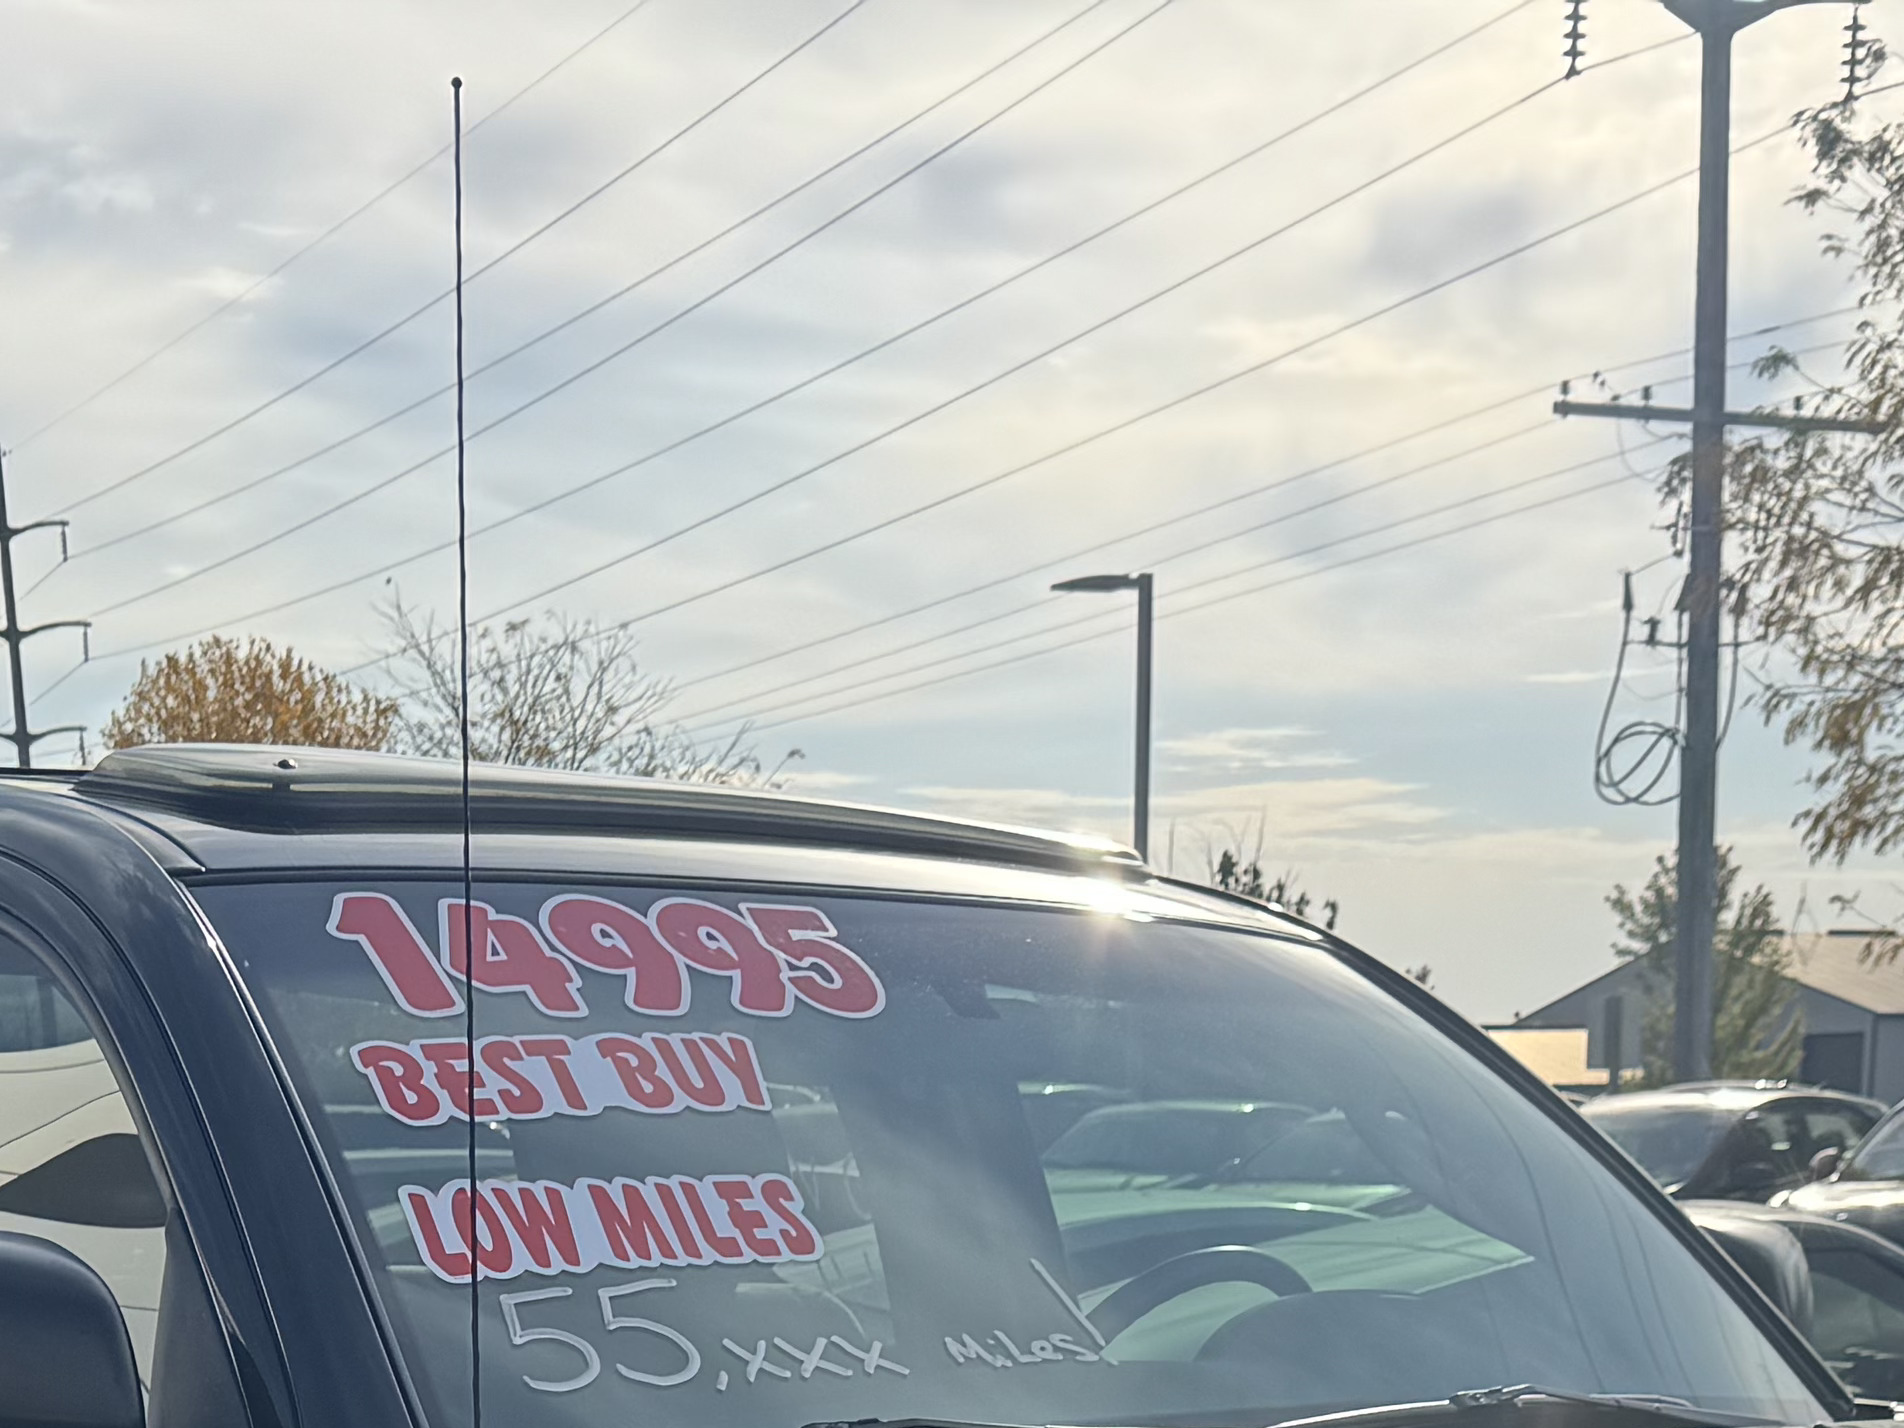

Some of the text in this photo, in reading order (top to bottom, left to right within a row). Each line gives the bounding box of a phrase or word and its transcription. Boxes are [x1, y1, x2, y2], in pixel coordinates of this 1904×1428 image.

[327, 892, 884, 1017] 14995
[354, 1034, 768, 1123] BEST BUY
[405, 1177, 820, 1280] LOW MILES
